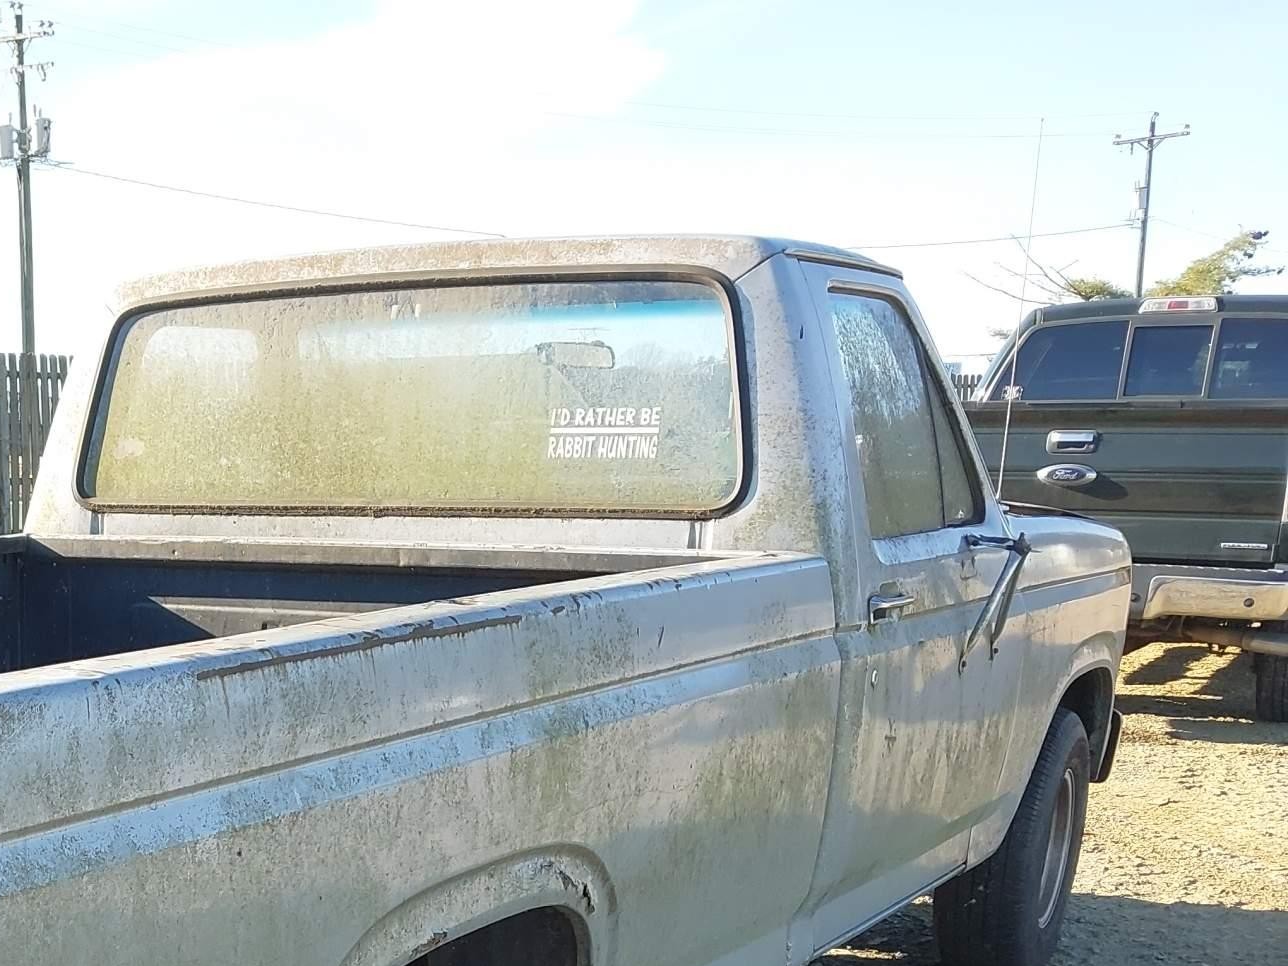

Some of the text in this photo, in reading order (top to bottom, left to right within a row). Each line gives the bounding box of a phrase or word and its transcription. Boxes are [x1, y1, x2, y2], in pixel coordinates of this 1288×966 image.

[550, 406, 662, 426] I'D RATHER BE
[547, 435, 658, 459] RABBIT HUNTING
[1052, 469, 1079, 481] Ford
